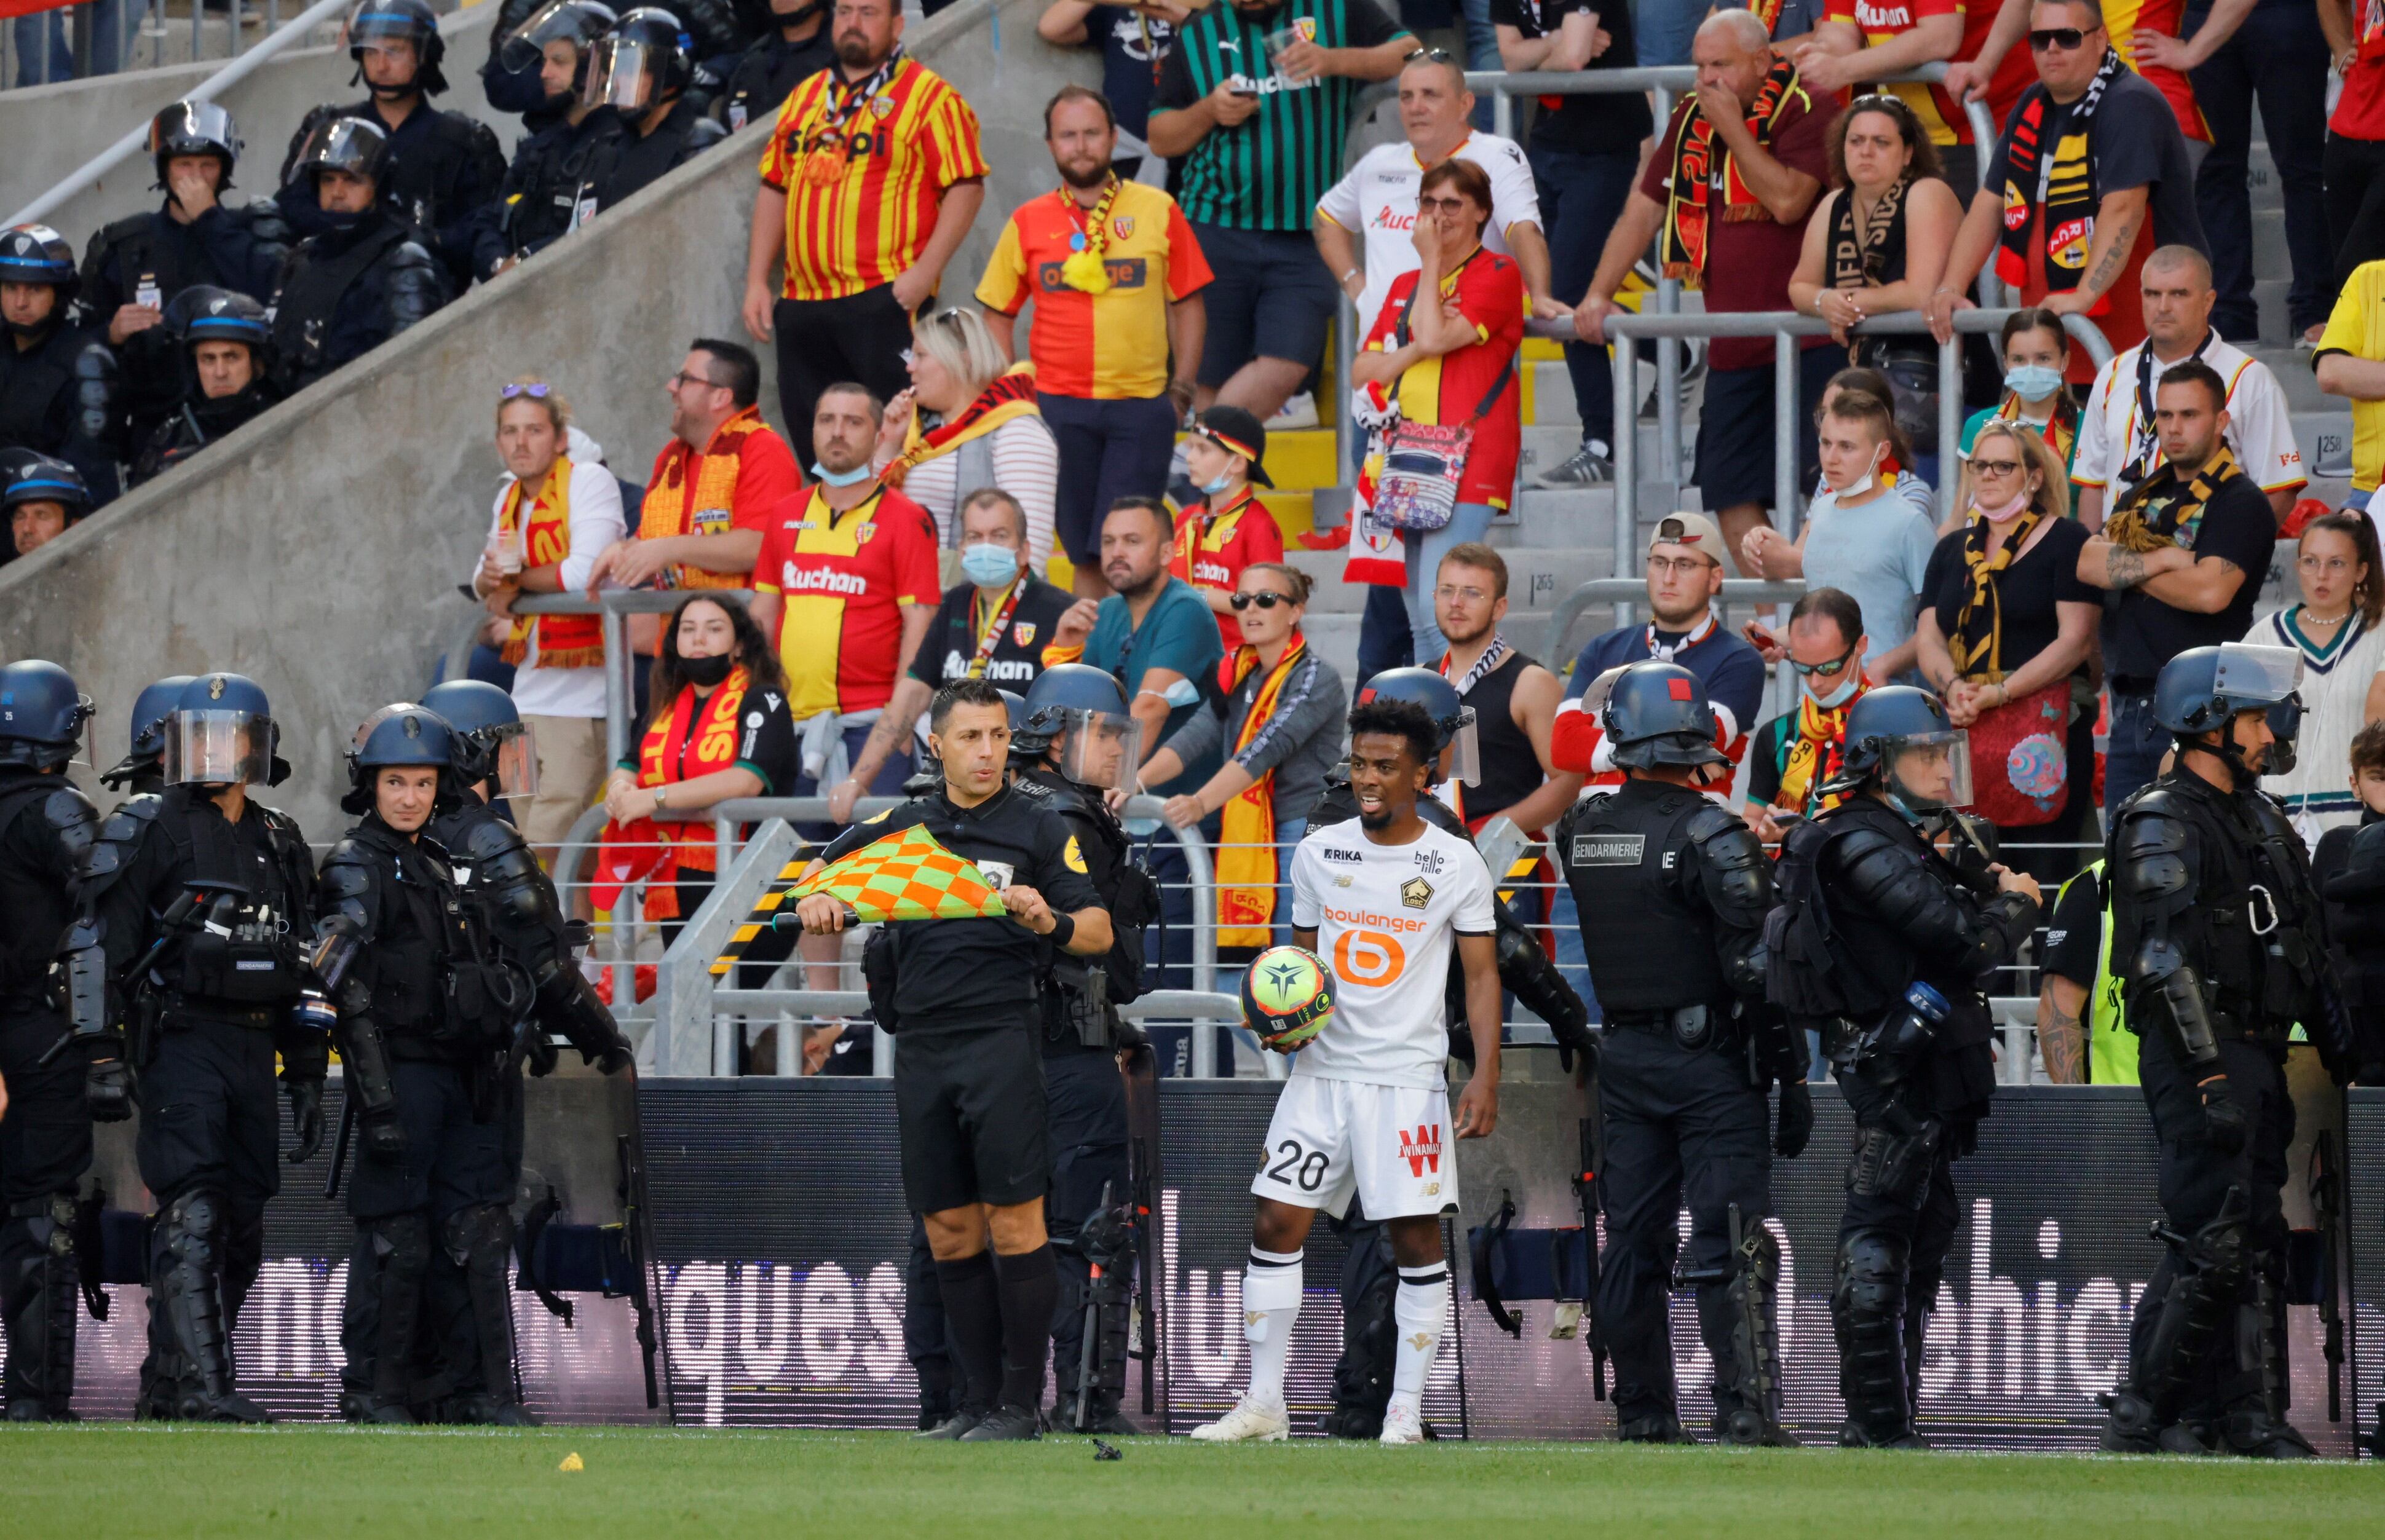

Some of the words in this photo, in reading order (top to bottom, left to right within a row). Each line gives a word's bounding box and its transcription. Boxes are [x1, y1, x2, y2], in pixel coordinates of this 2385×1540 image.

[1370, 204, 1422, 232] Auc
[1045, 265, 1134, 287] oge
[783, 560, 867, 595] Auchan
[942, 649, 1034, 681] Auhan
[1334, 849, 1363, 861] RIKA
[1575, 843, 1641, 858] GENDARMERIE
[1662, 851, 1675, 869] IE
[1406, 897, 1423, 906] LOSC
[1324, 904, 1427, 933] boulanger
[1402, 1142, 1441, 1158] WINAMAX
[1267, 1139, 1330, 1192] 20
[659, 1261, 906, 1429] ques
